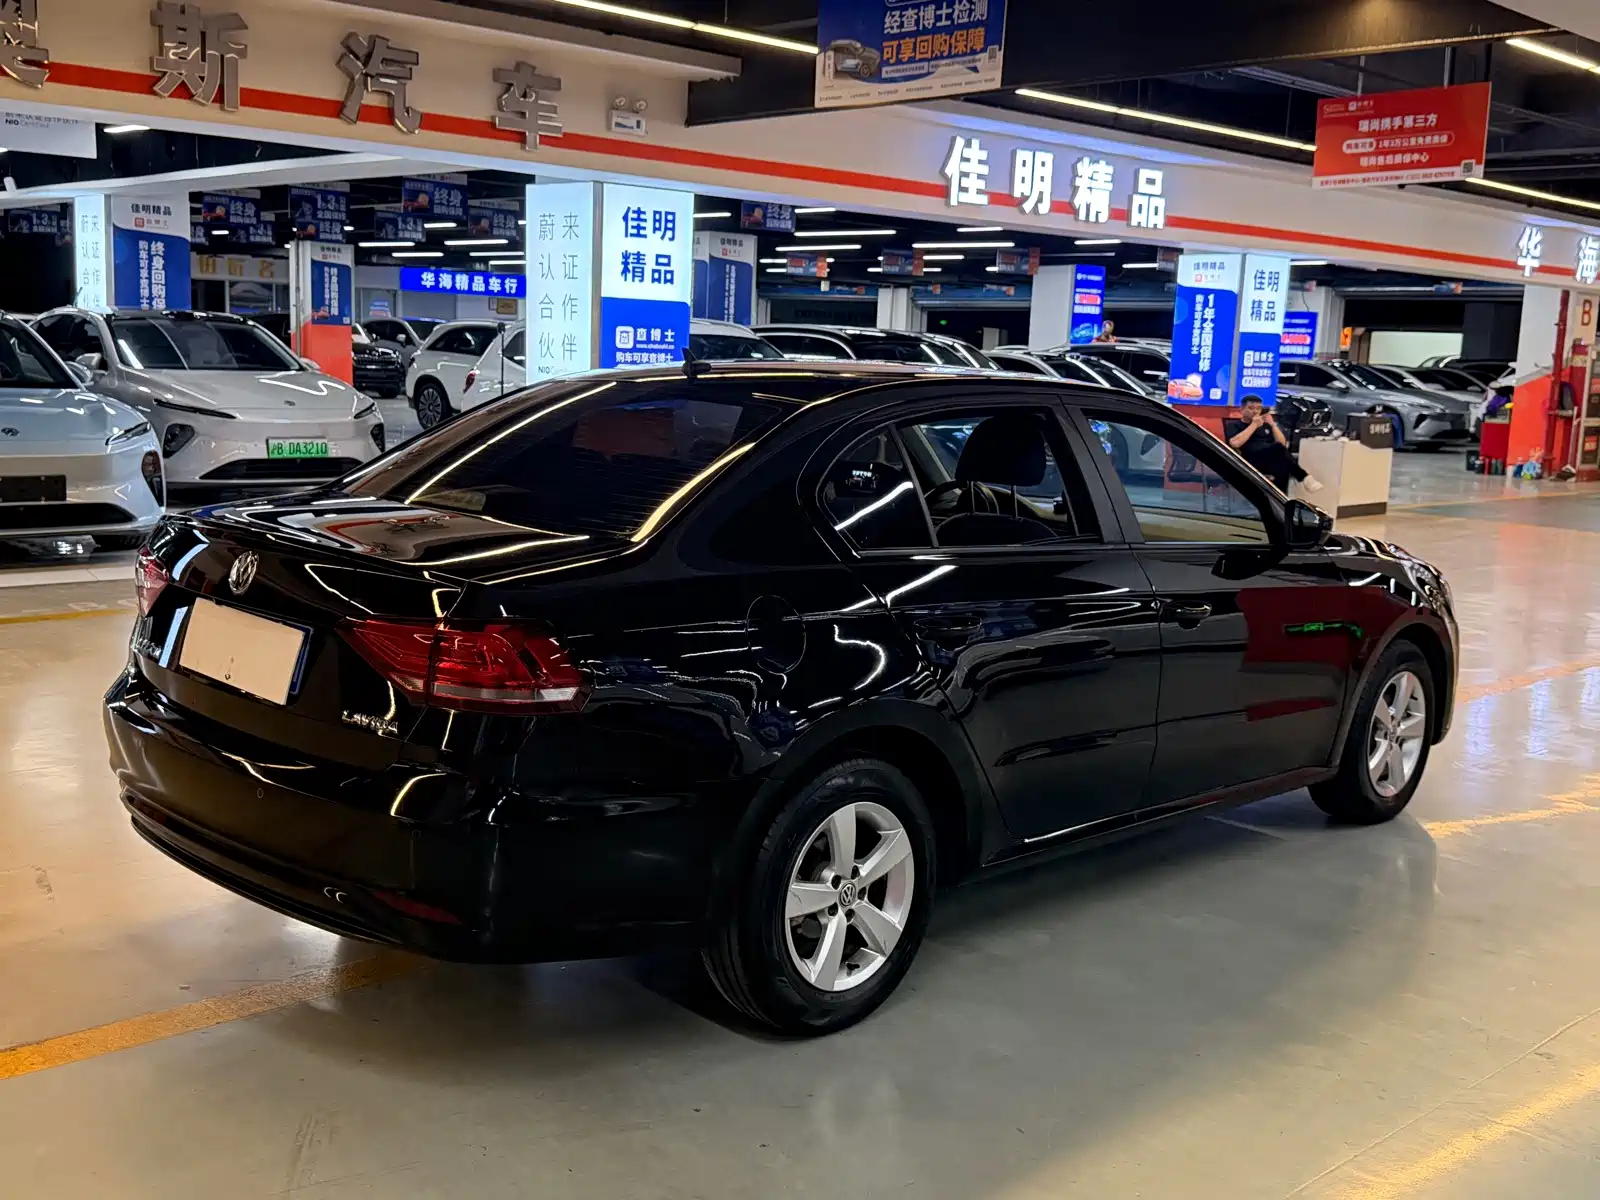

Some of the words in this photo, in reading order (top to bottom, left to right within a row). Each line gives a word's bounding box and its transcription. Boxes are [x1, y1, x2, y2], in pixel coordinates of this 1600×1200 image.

[882, 27, 985, 64] 可享回购保障
[941, 133, 1166, 230] 佳明精品
[538, 212, 579, 241] 蔚来
[622, 206, 676, 242] 佳明
[538, 253, 579, 281] 认证
[620, 250, 675, 285] 精品
[1253, 269, 1280, 292] 佳明
[420, 271, 518, 294] 华海精品车行
[538, 293, 579, 321] 合作
[1250, 299, 1276, 322] 精品
[1581, 299, 1592, 327] B
[538, 331, 578, 361] 伙伴
[289, 441, 328, 456] DA3210
